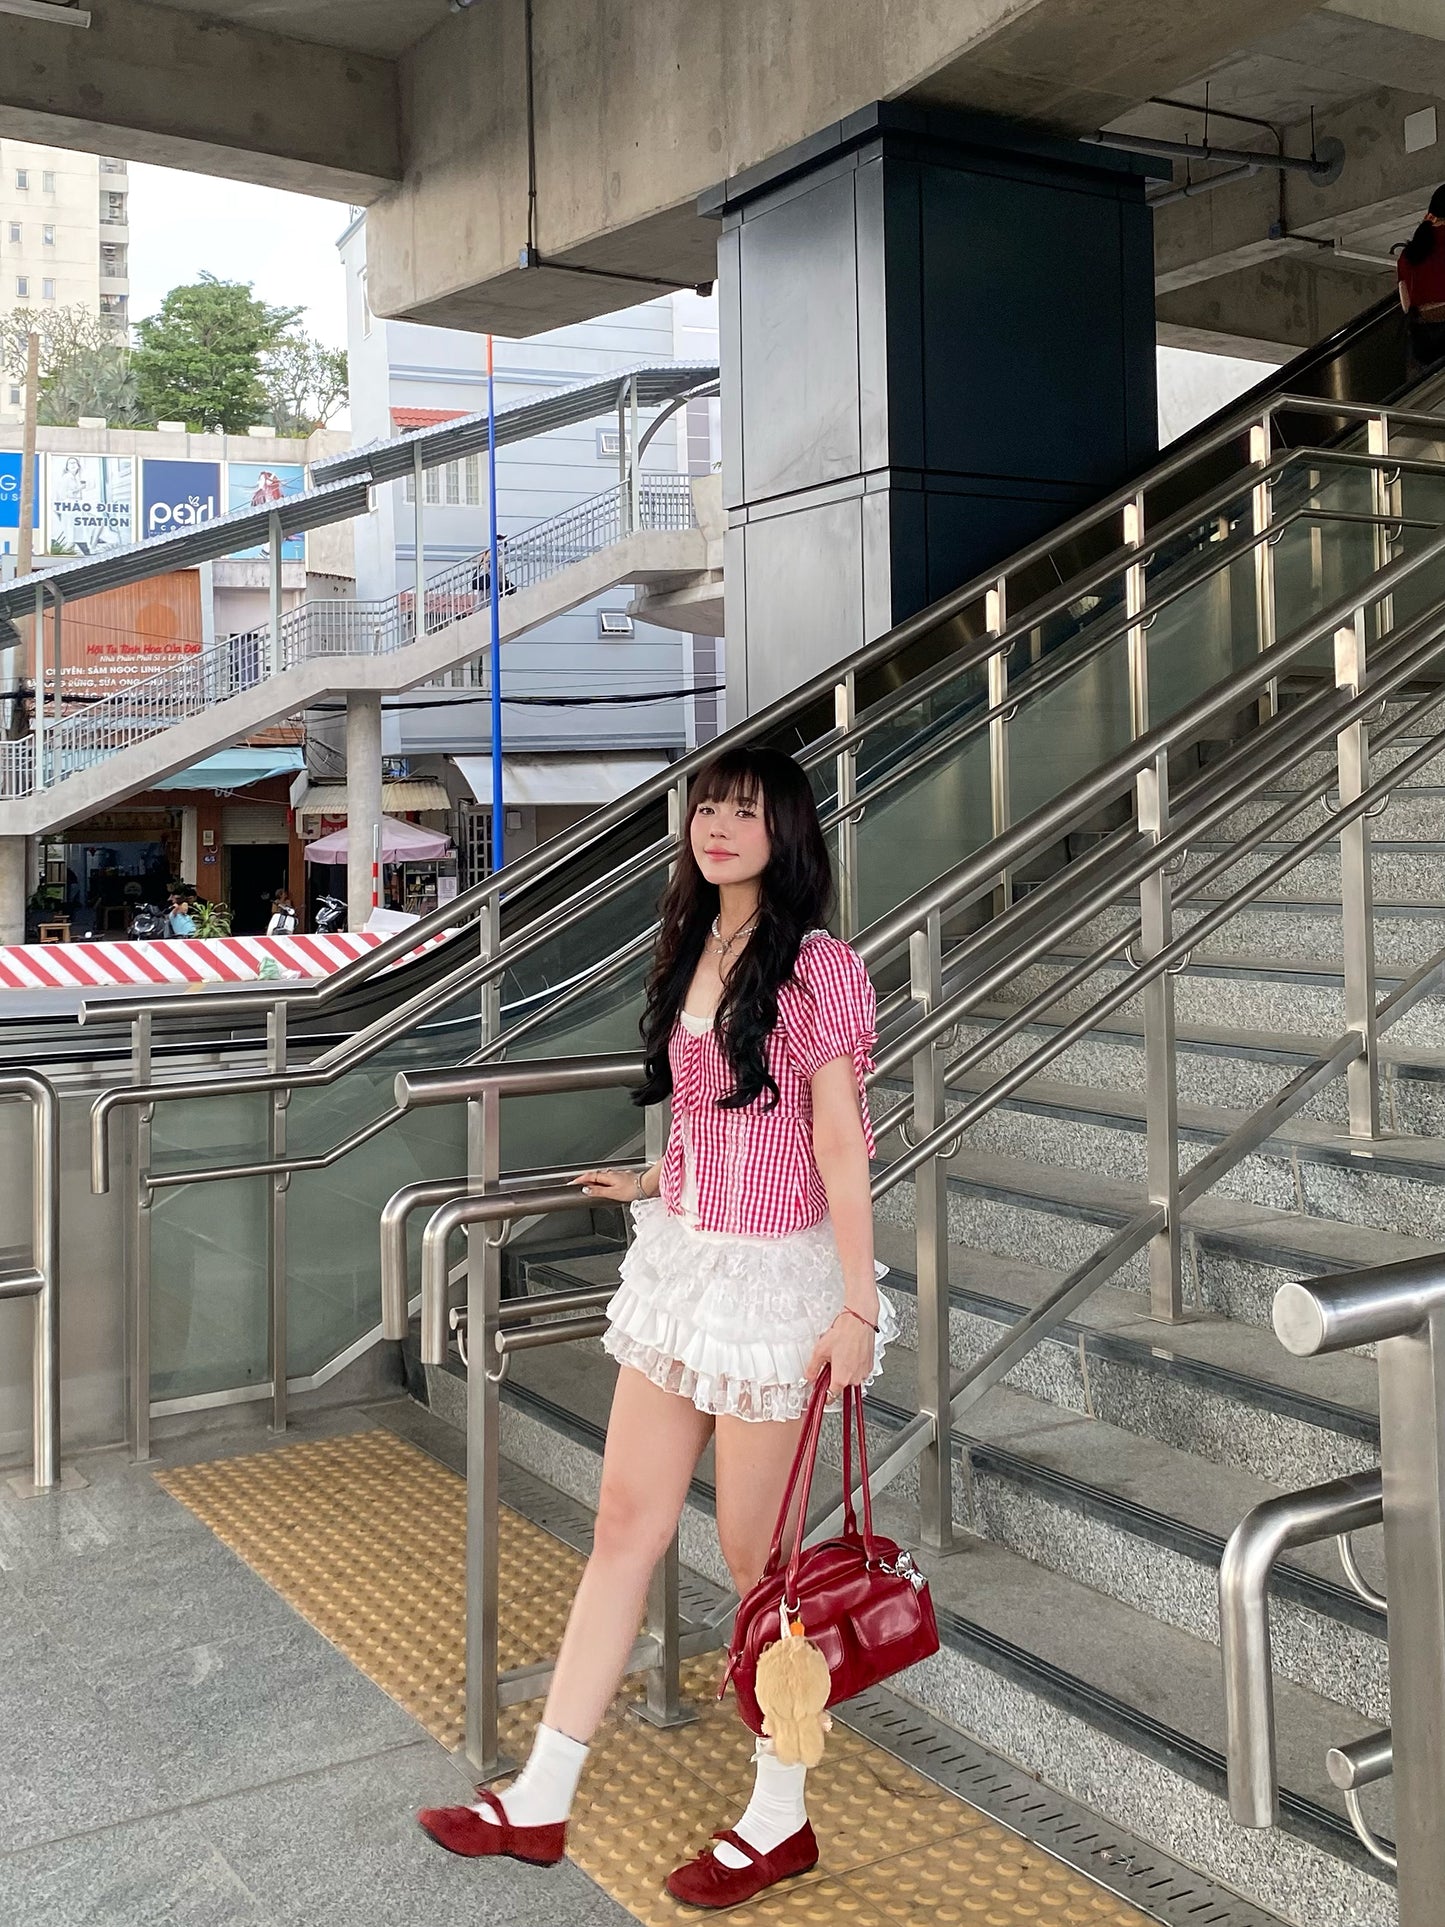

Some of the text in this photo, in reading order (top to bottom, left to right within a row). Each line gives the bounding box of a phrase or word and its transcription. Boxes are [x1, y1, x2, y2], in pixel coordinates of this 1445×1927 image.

[149, 496, 214, 531] pearl
[74, 517, 129, 527] STATION
[110, 666, 138, 676] NGỌC
